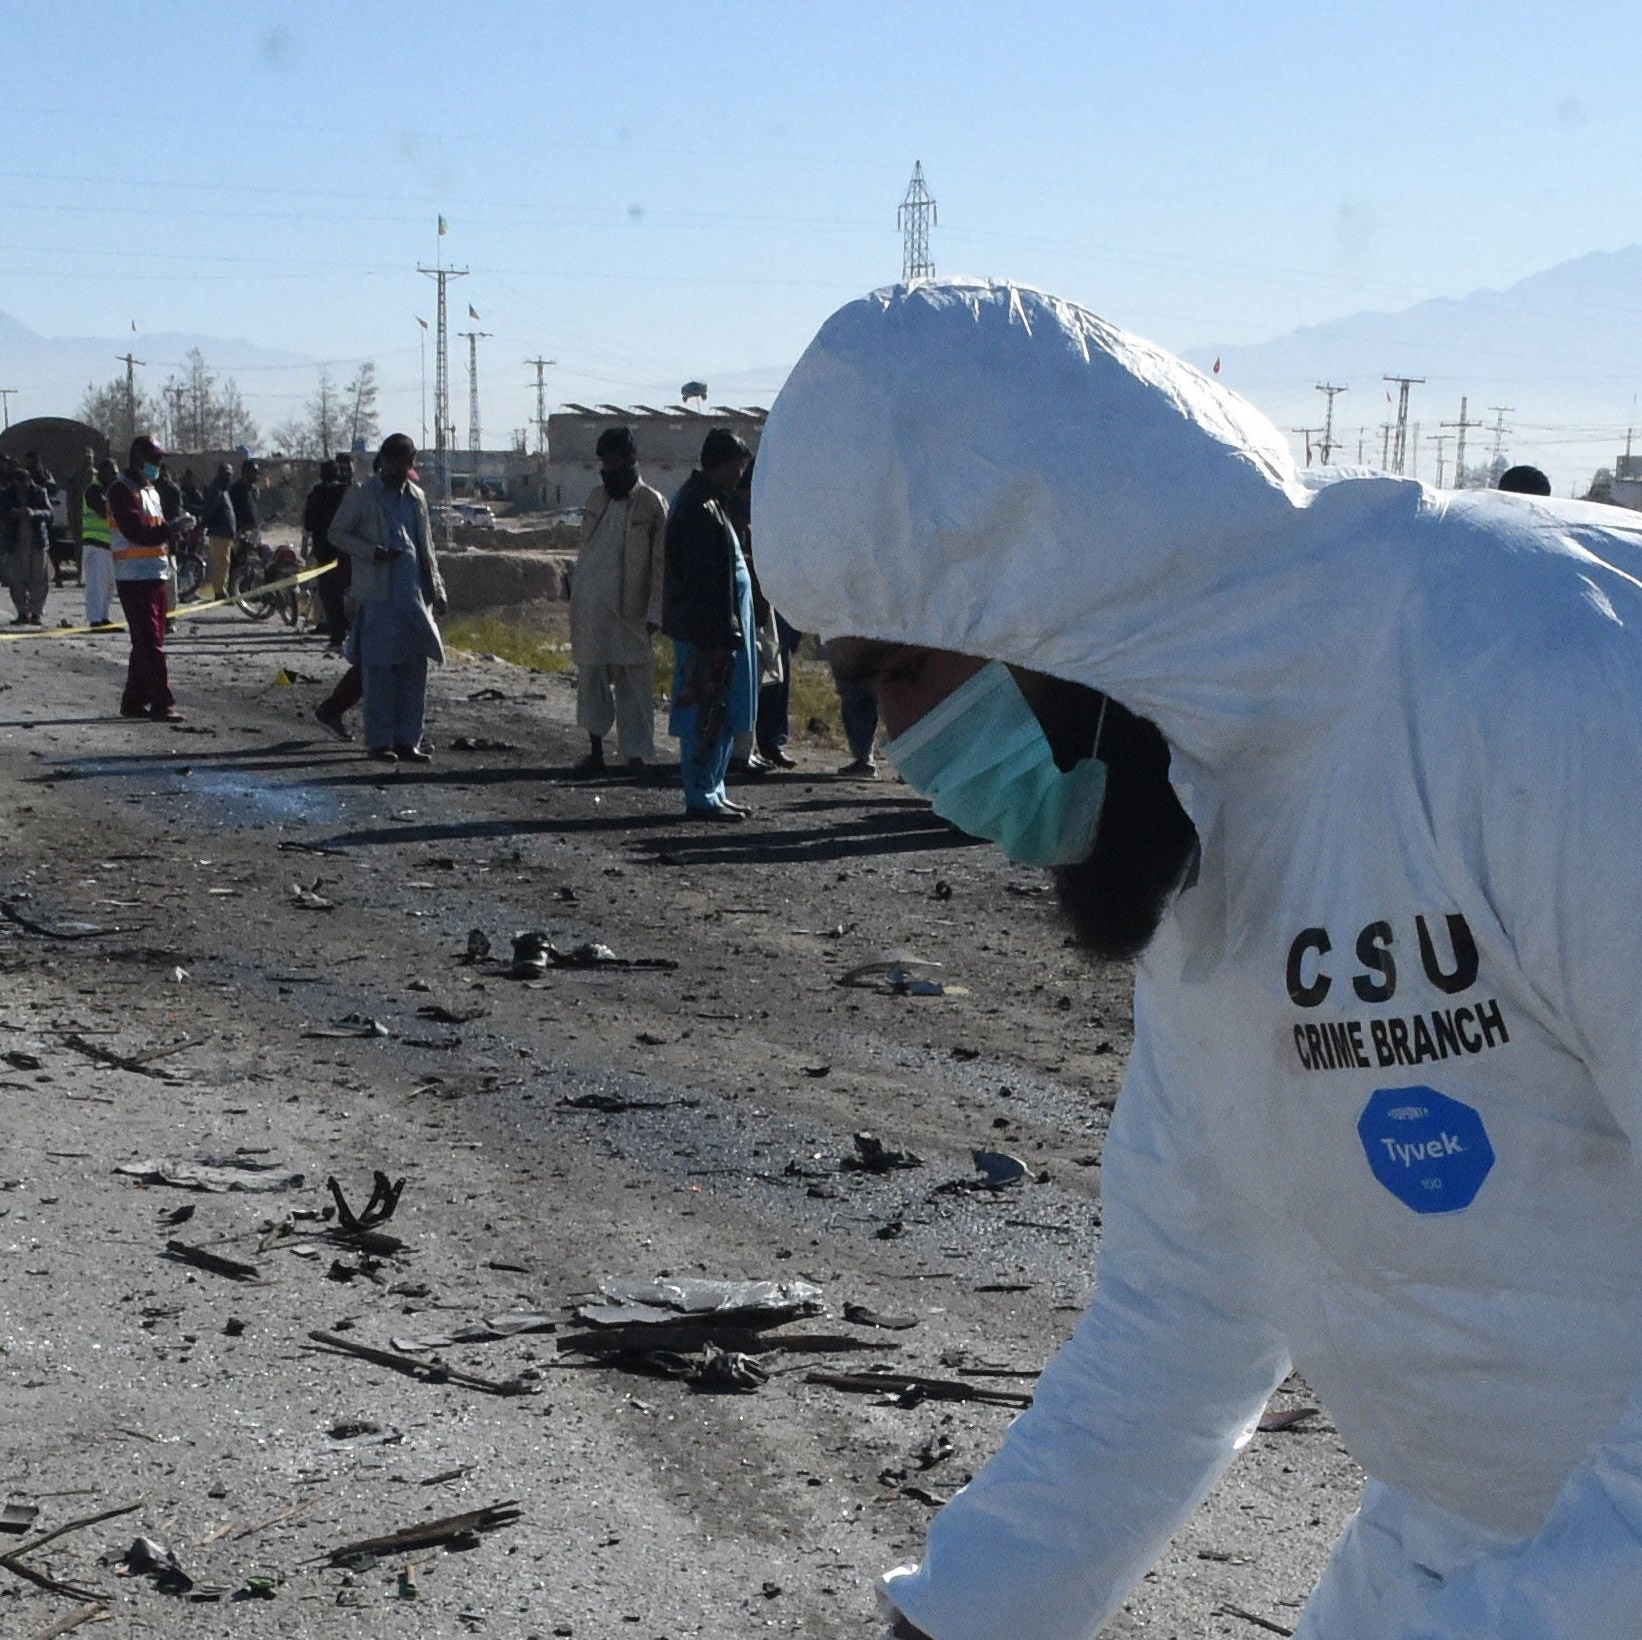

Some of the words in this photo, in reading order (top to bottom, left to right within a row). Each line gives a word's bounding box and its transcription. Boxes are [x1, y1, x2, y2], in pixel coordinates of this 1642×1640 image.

[1293, 1020, 1371, 1071] CRIME
[1370, 998, 1511, 1068] BRANCH
[1380, 1131, 1464, 1168] Tyvek
